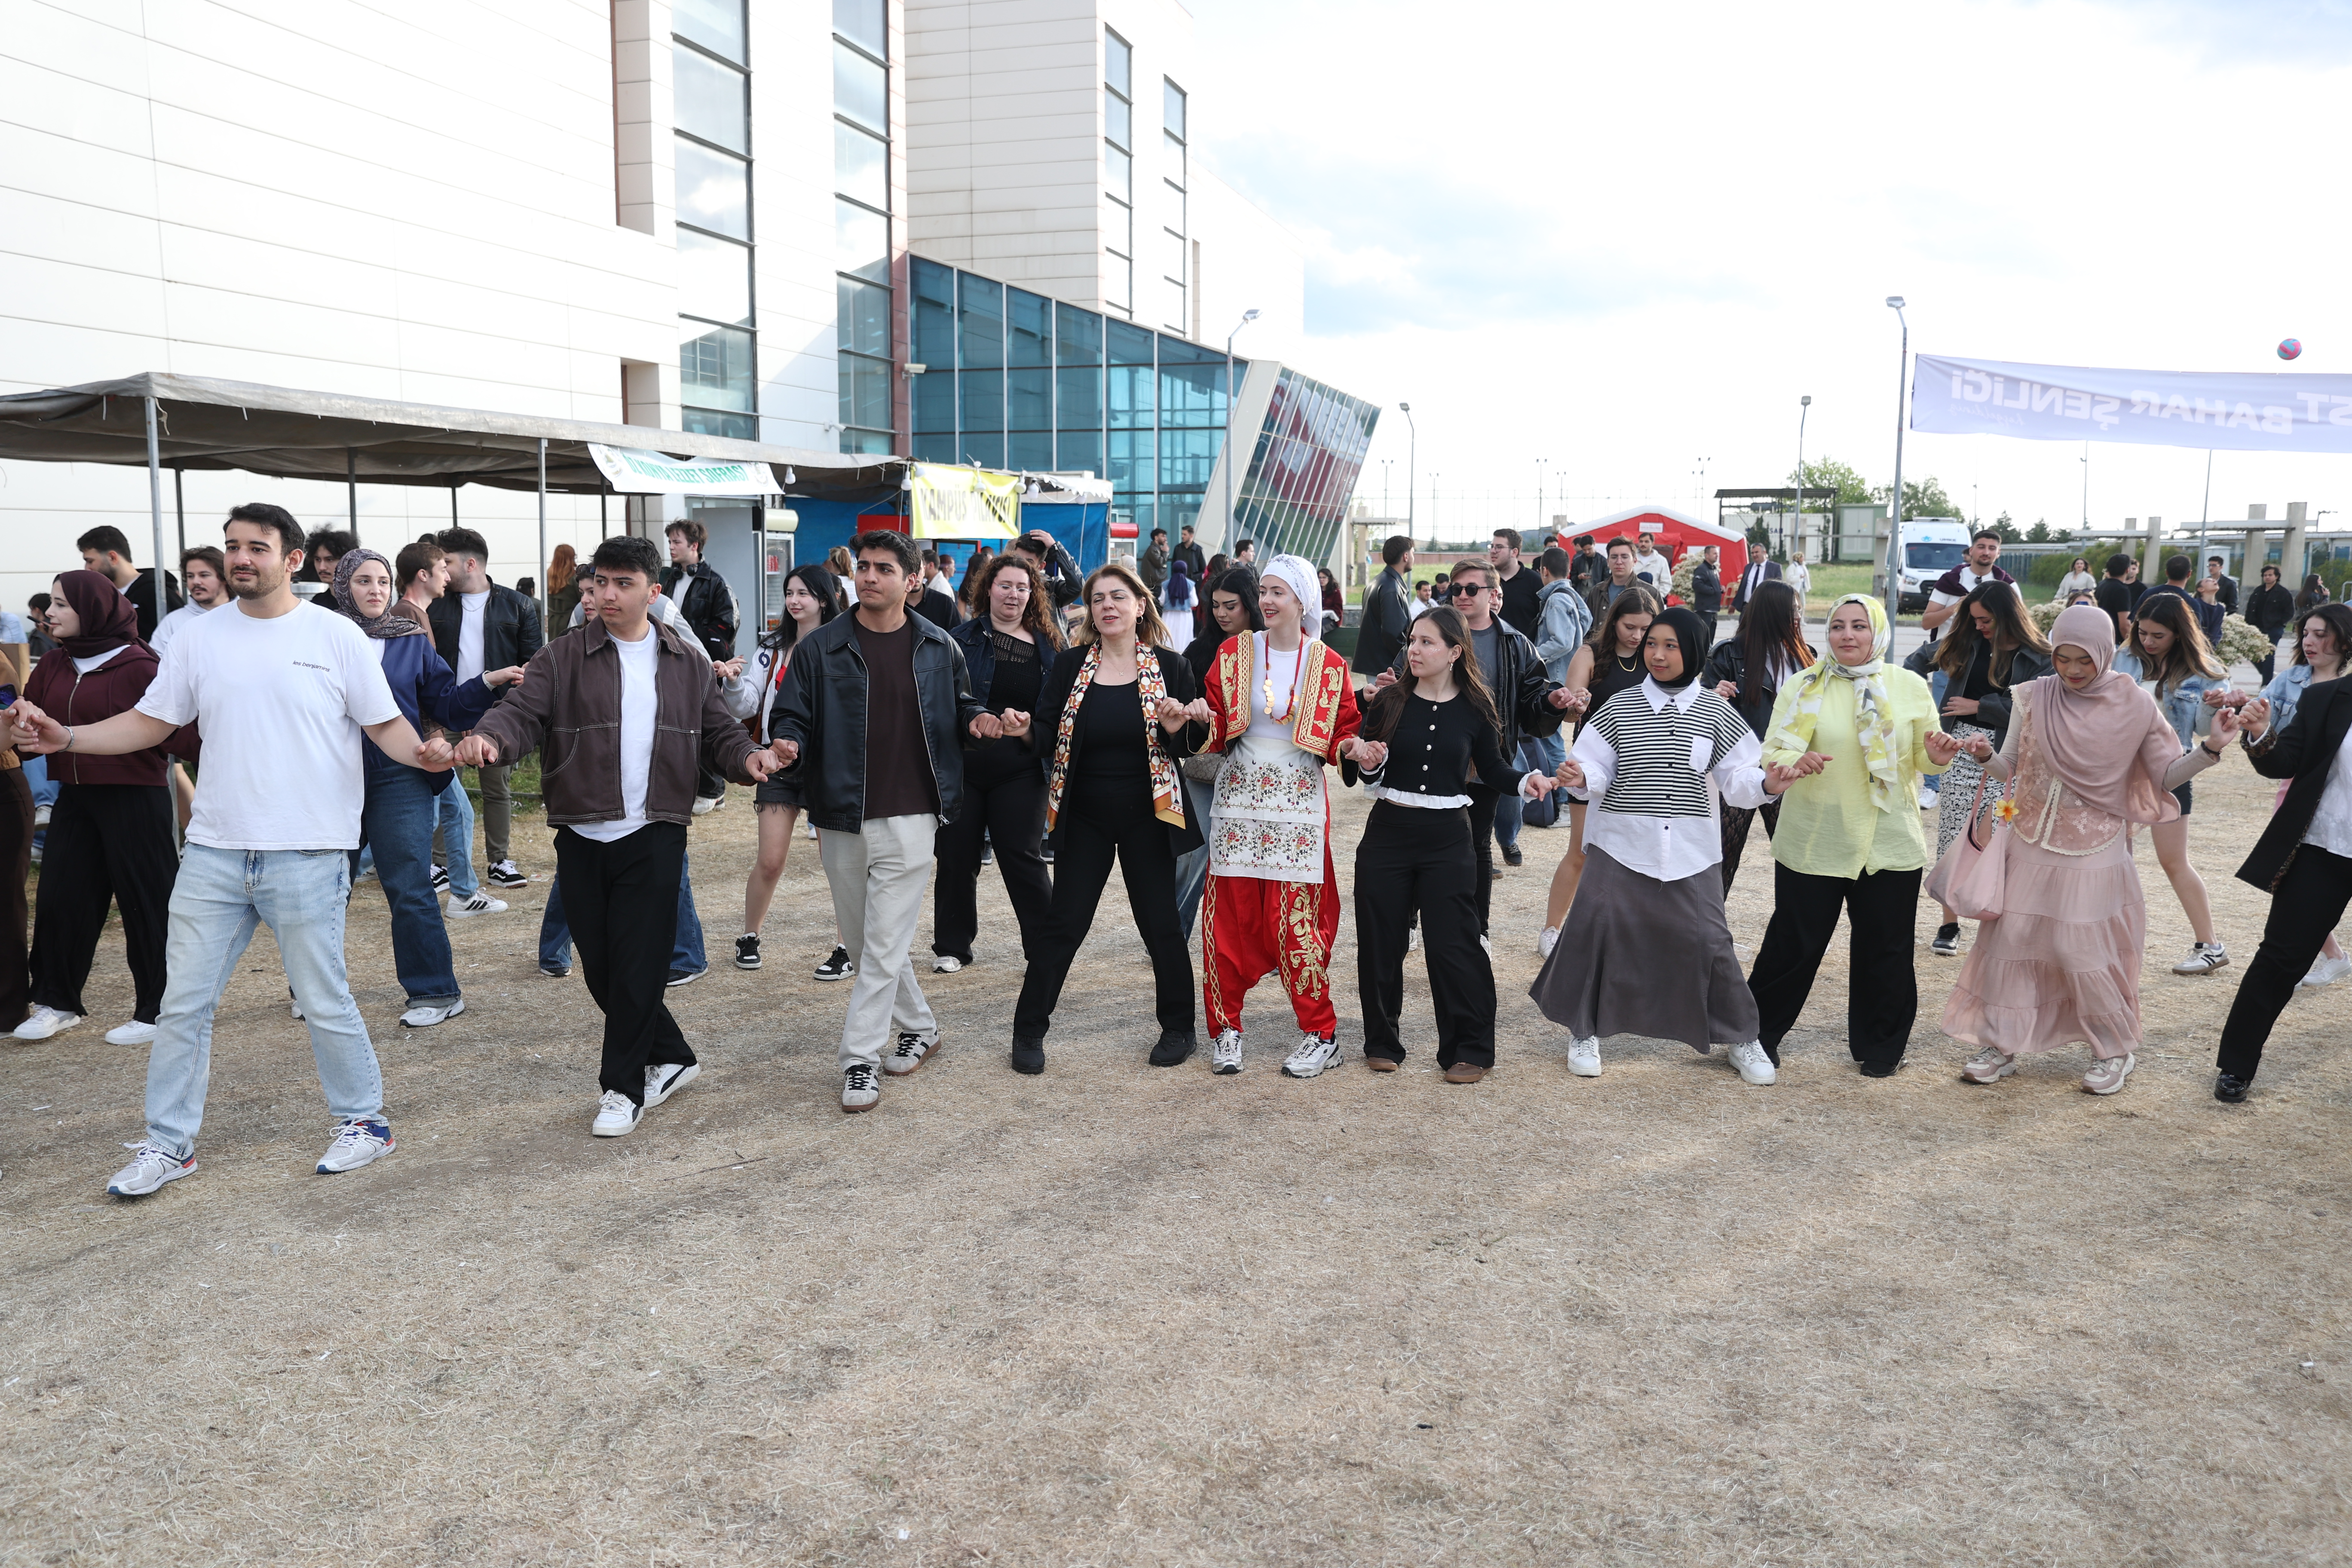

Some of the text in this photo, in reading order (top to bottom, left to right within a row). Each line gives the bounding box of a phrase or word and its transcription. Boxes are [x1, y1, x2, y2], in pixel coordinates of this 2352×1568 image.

[634, 459, 674, 481] KONYA
[665, 466, 705, 484] LEZZET
[698, 465, 749, 484] SOFRASI
[920, 484, 967, 521] KAMPÜS
[302, 662, 330, 672] benjamins
